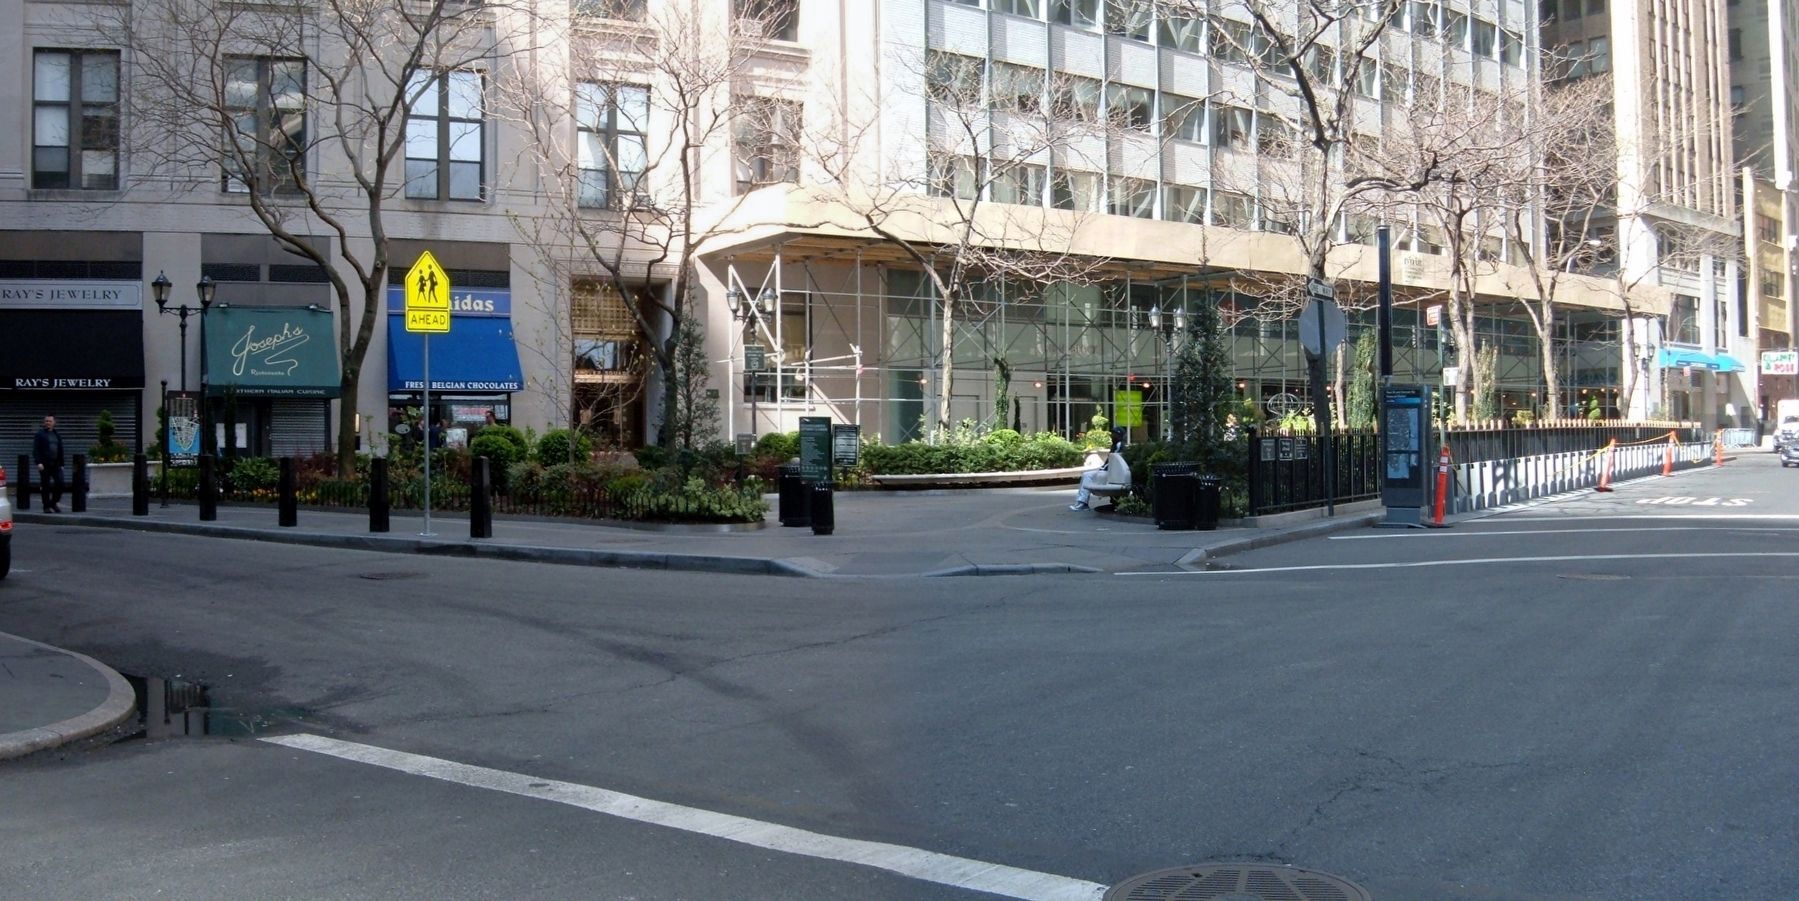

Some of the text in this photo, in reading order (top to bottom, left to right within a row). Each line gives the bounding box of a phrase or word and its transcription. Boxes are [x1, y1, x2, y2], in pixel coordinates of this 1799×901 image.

[2, 289, 122, 300] RAY'S JEWELRY
[410, 314, 446, 325] AHEAD
[15, 378, 112, 388] RAY'S JEWELRY
[405, 381, 518, 390] FRES BELGIAN CHOCOLATES
